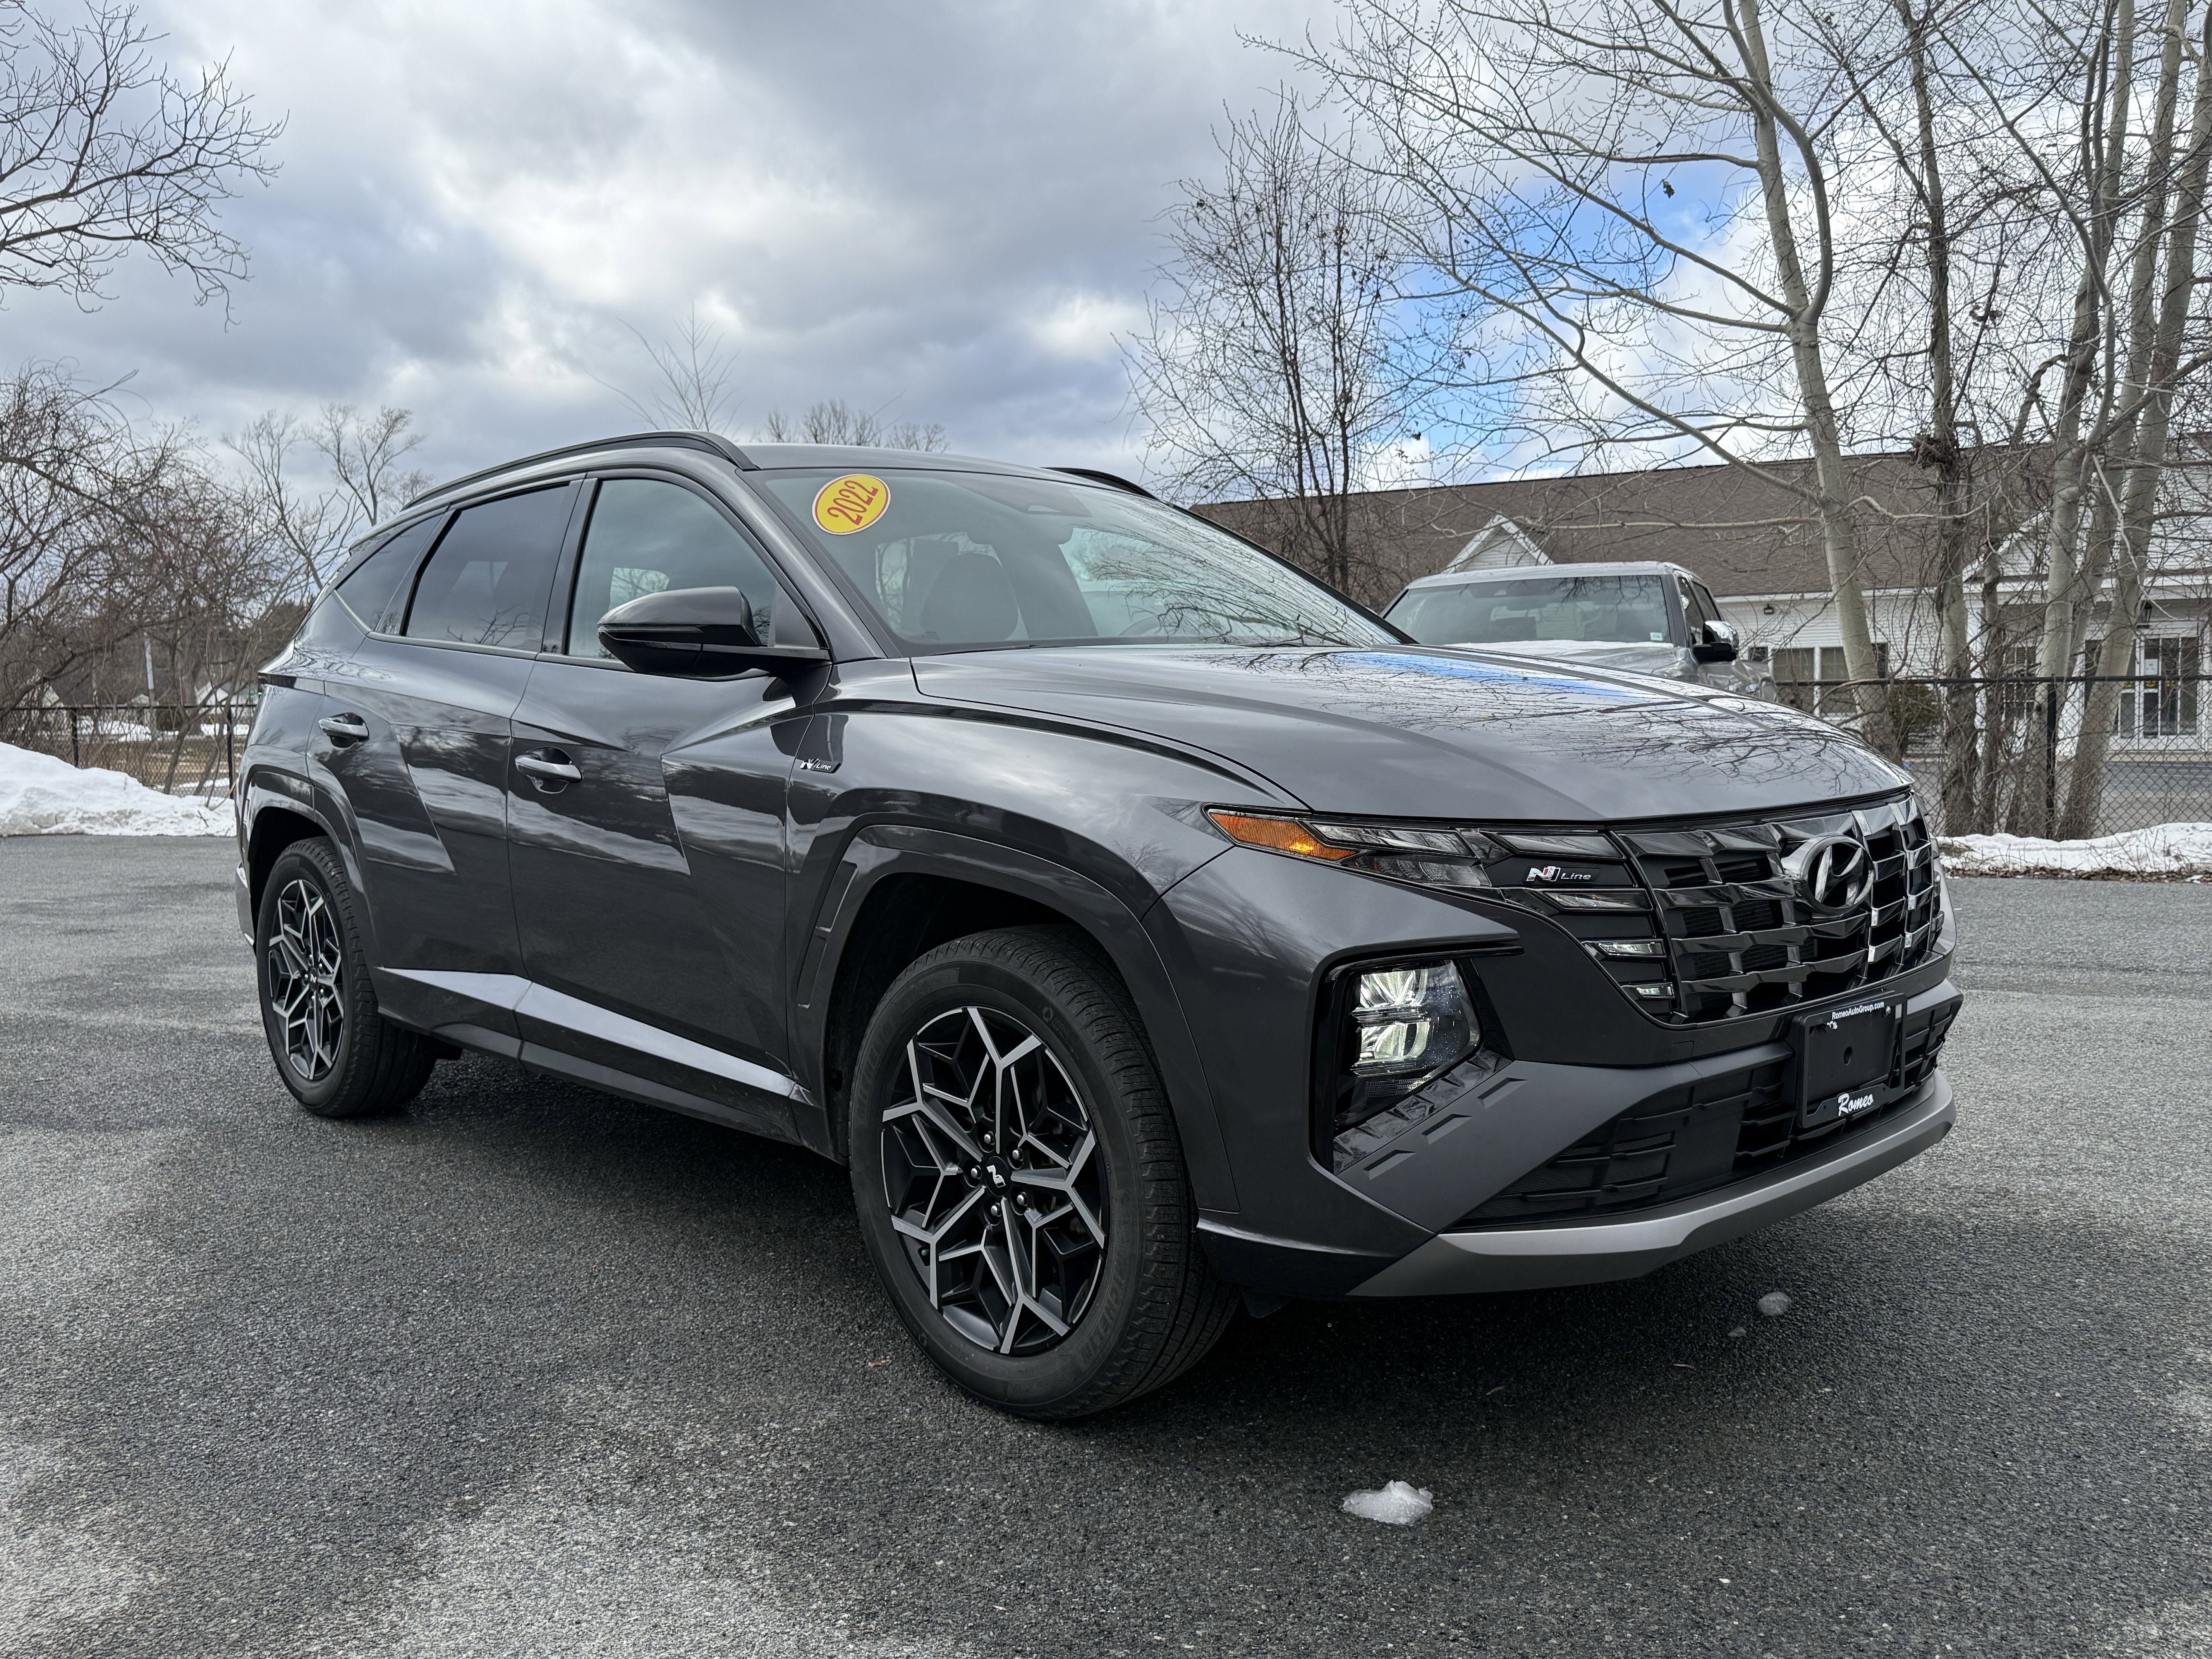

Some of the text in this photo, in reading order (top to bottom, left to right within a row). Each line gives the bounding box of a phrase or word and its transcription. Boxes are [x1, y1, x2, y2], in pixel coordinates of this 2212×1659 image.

[827, 480, 879, 526] 2022
[1832, 1001, 1884, 1020] RomeoAutoGroup.com
[1838, 1093, 1874, 1116] Romeo
